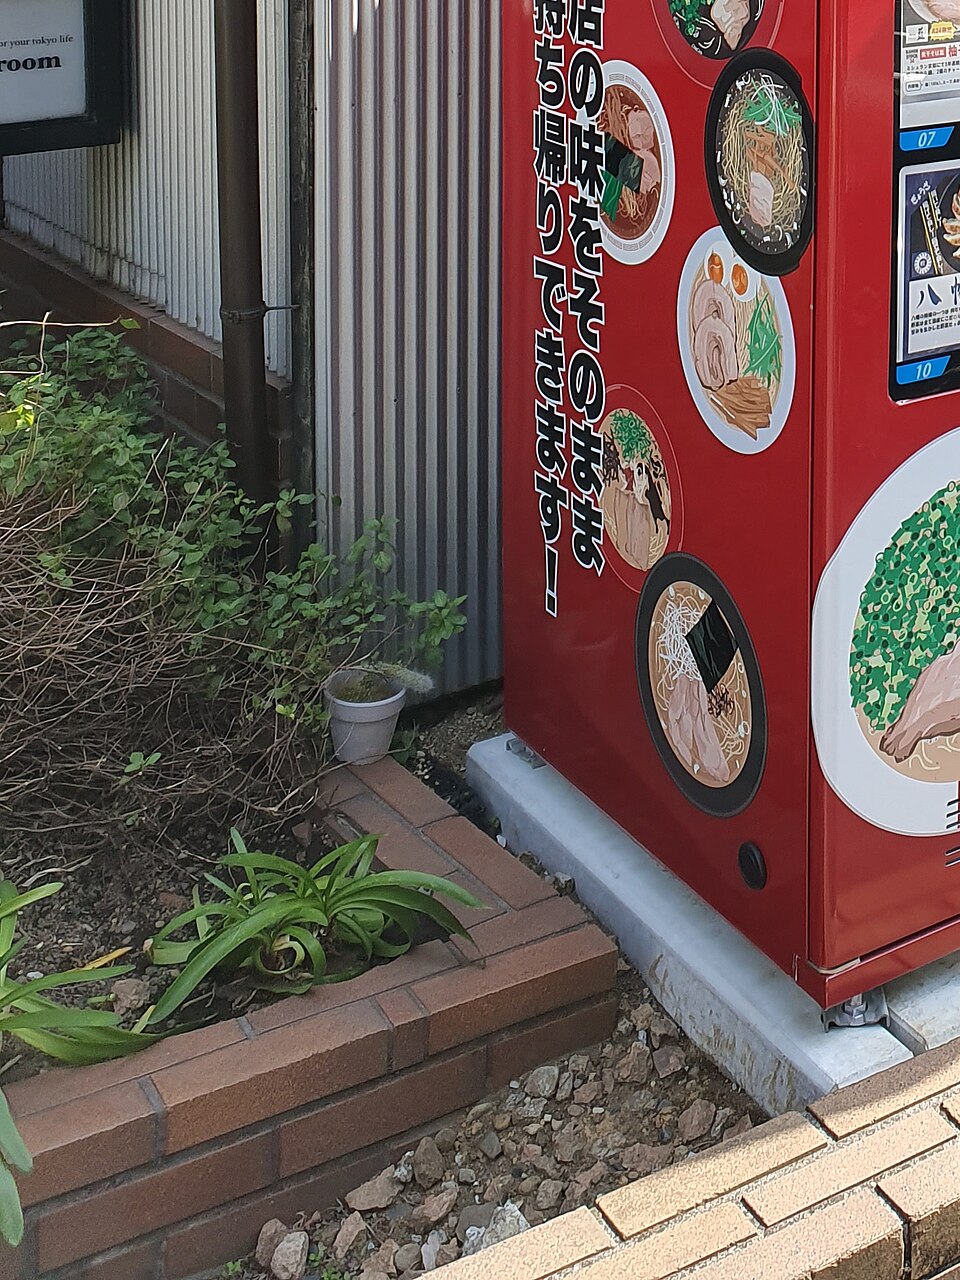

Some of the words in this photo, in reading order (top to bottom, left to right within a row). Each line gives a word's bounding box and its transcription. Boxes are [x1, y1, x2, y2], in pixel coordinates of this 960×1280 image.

[9, 39, 30, 49] your
[32, 36, 57, 47] tokyo
[59, 34, 74, 43] life
[918, 131, 936, 148] 07
[915, 362, 932, 379] 10
